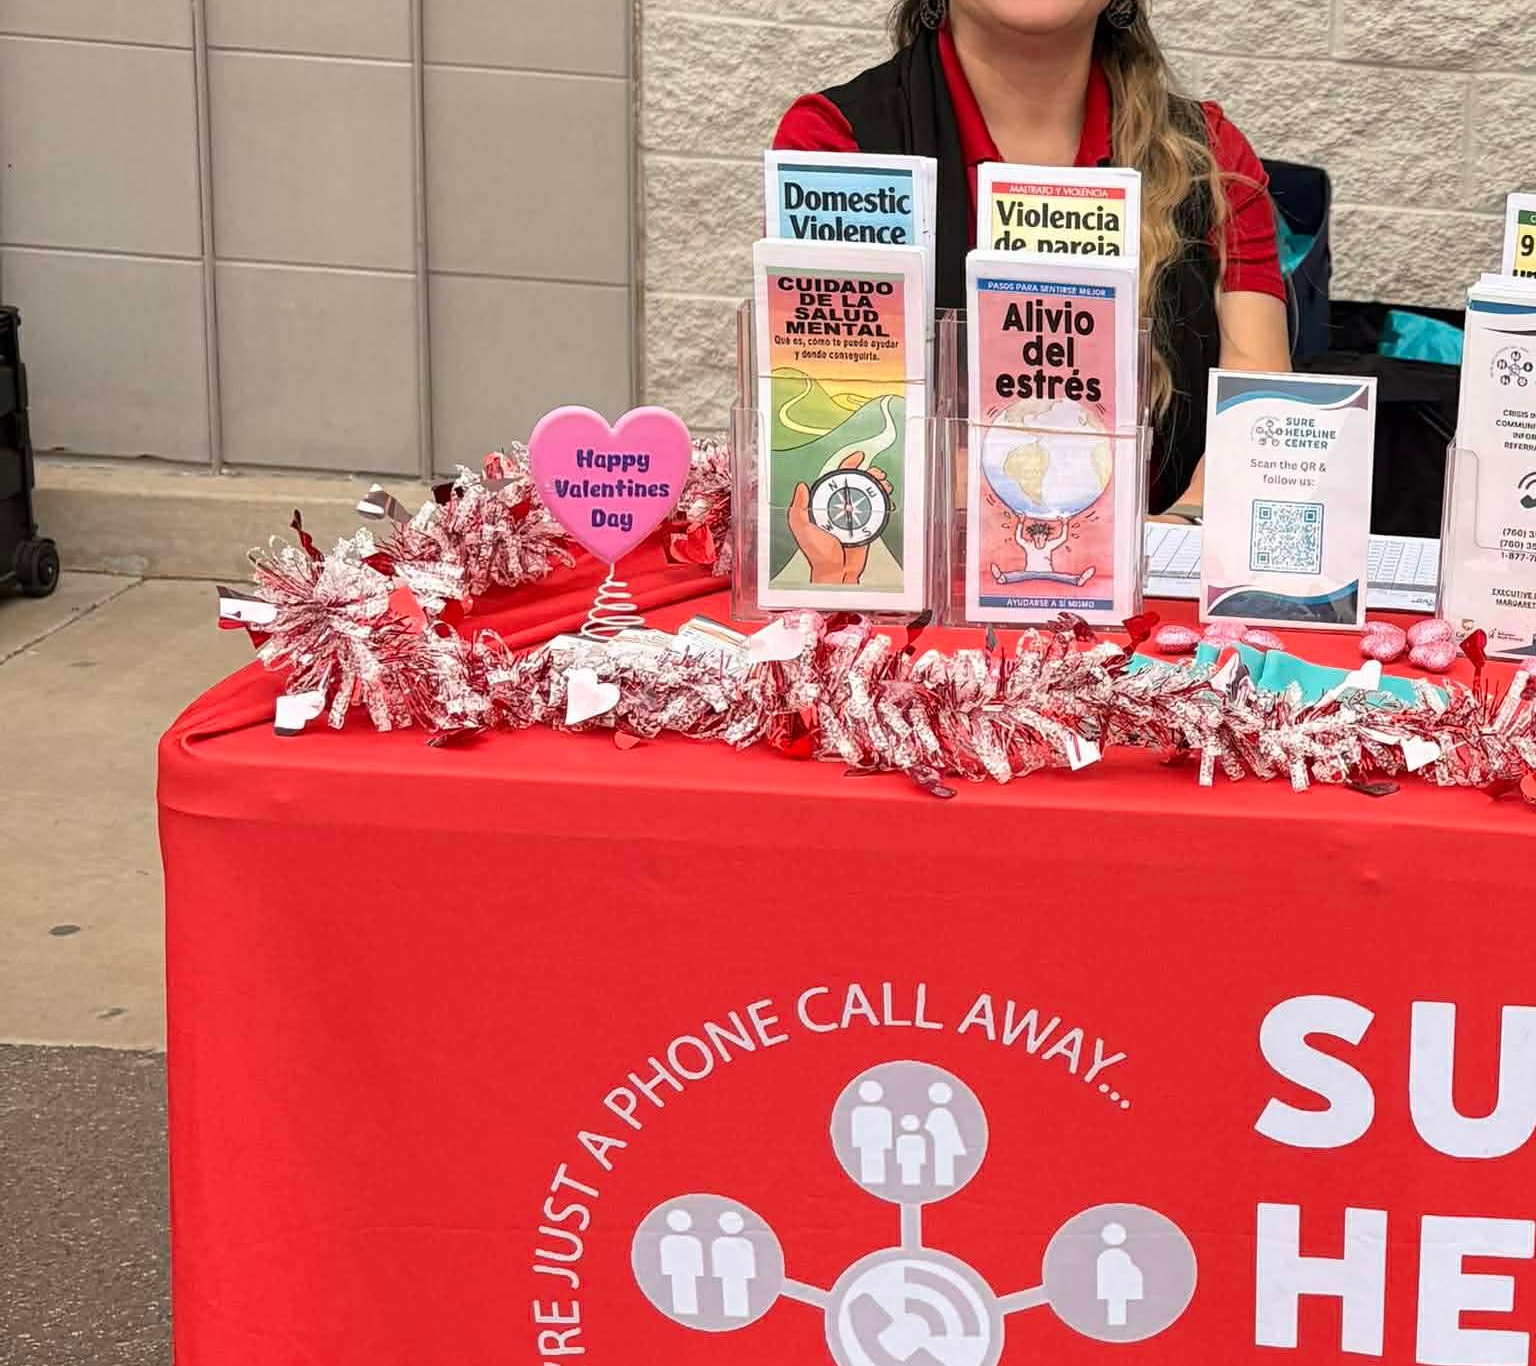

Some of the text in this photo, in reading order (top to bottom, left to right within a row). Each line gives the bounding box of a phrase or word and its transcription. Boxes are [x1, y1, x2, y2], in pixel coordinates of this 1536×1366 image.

[784, 181, 912, 215] Domestic
[1009, 184, 1108, 198] MALTRATO Y VIOLENCIA
[996, 200, 1120, 232] Violencia
[789, 214, 907, 245] Violence
[994, 230, 1027, 252] de
[1520, 235, 1535, 256] 9
[777, 276, 893, 295] CUIDADO
[988, 281, 1106, 297] PASOS PARA SENTIRSE MEJOR
[799, 293, 873, 308] DE LA
[795, 308, 879, 323] SALUD
[1002, 299, 1095, 336] Alivio
[786, 321, 890, 337] MENTAL
[843, 338, 868, 349] puede
[871, 339, 899, 351] ayudar
[1022, 335, 1074, 368] del
[794, 352, 799, 361] y
[995, 369, 1102, 403] estrés
[1502, 409, 1529, 418] CRISIS
[1285, 416, 1316, 428] SURE
[1284, 427, 1337, 440] HELPLINE
[1284, 438, 1329, 450] CENTER
[576, 448, 650, 473] Happy
[1250, 458, 1327, 472] Scan the QR &
[554, 479, 670, 498] Valentines
[828, 479, 838, 492] N
[1263, 474, 1315, 487] follow us:
[591, 508, 633, 532] Day
[1492, 587, 1533, 598] EXECUTIVE
[1051, 599, 1057, 608] A
[533, 1162, 600, 1290] JUST
[577, 1129, 627, 1171] A
[603, 998, 790, 1130] PHONE
[797, 981, 944, 1032] CALL
